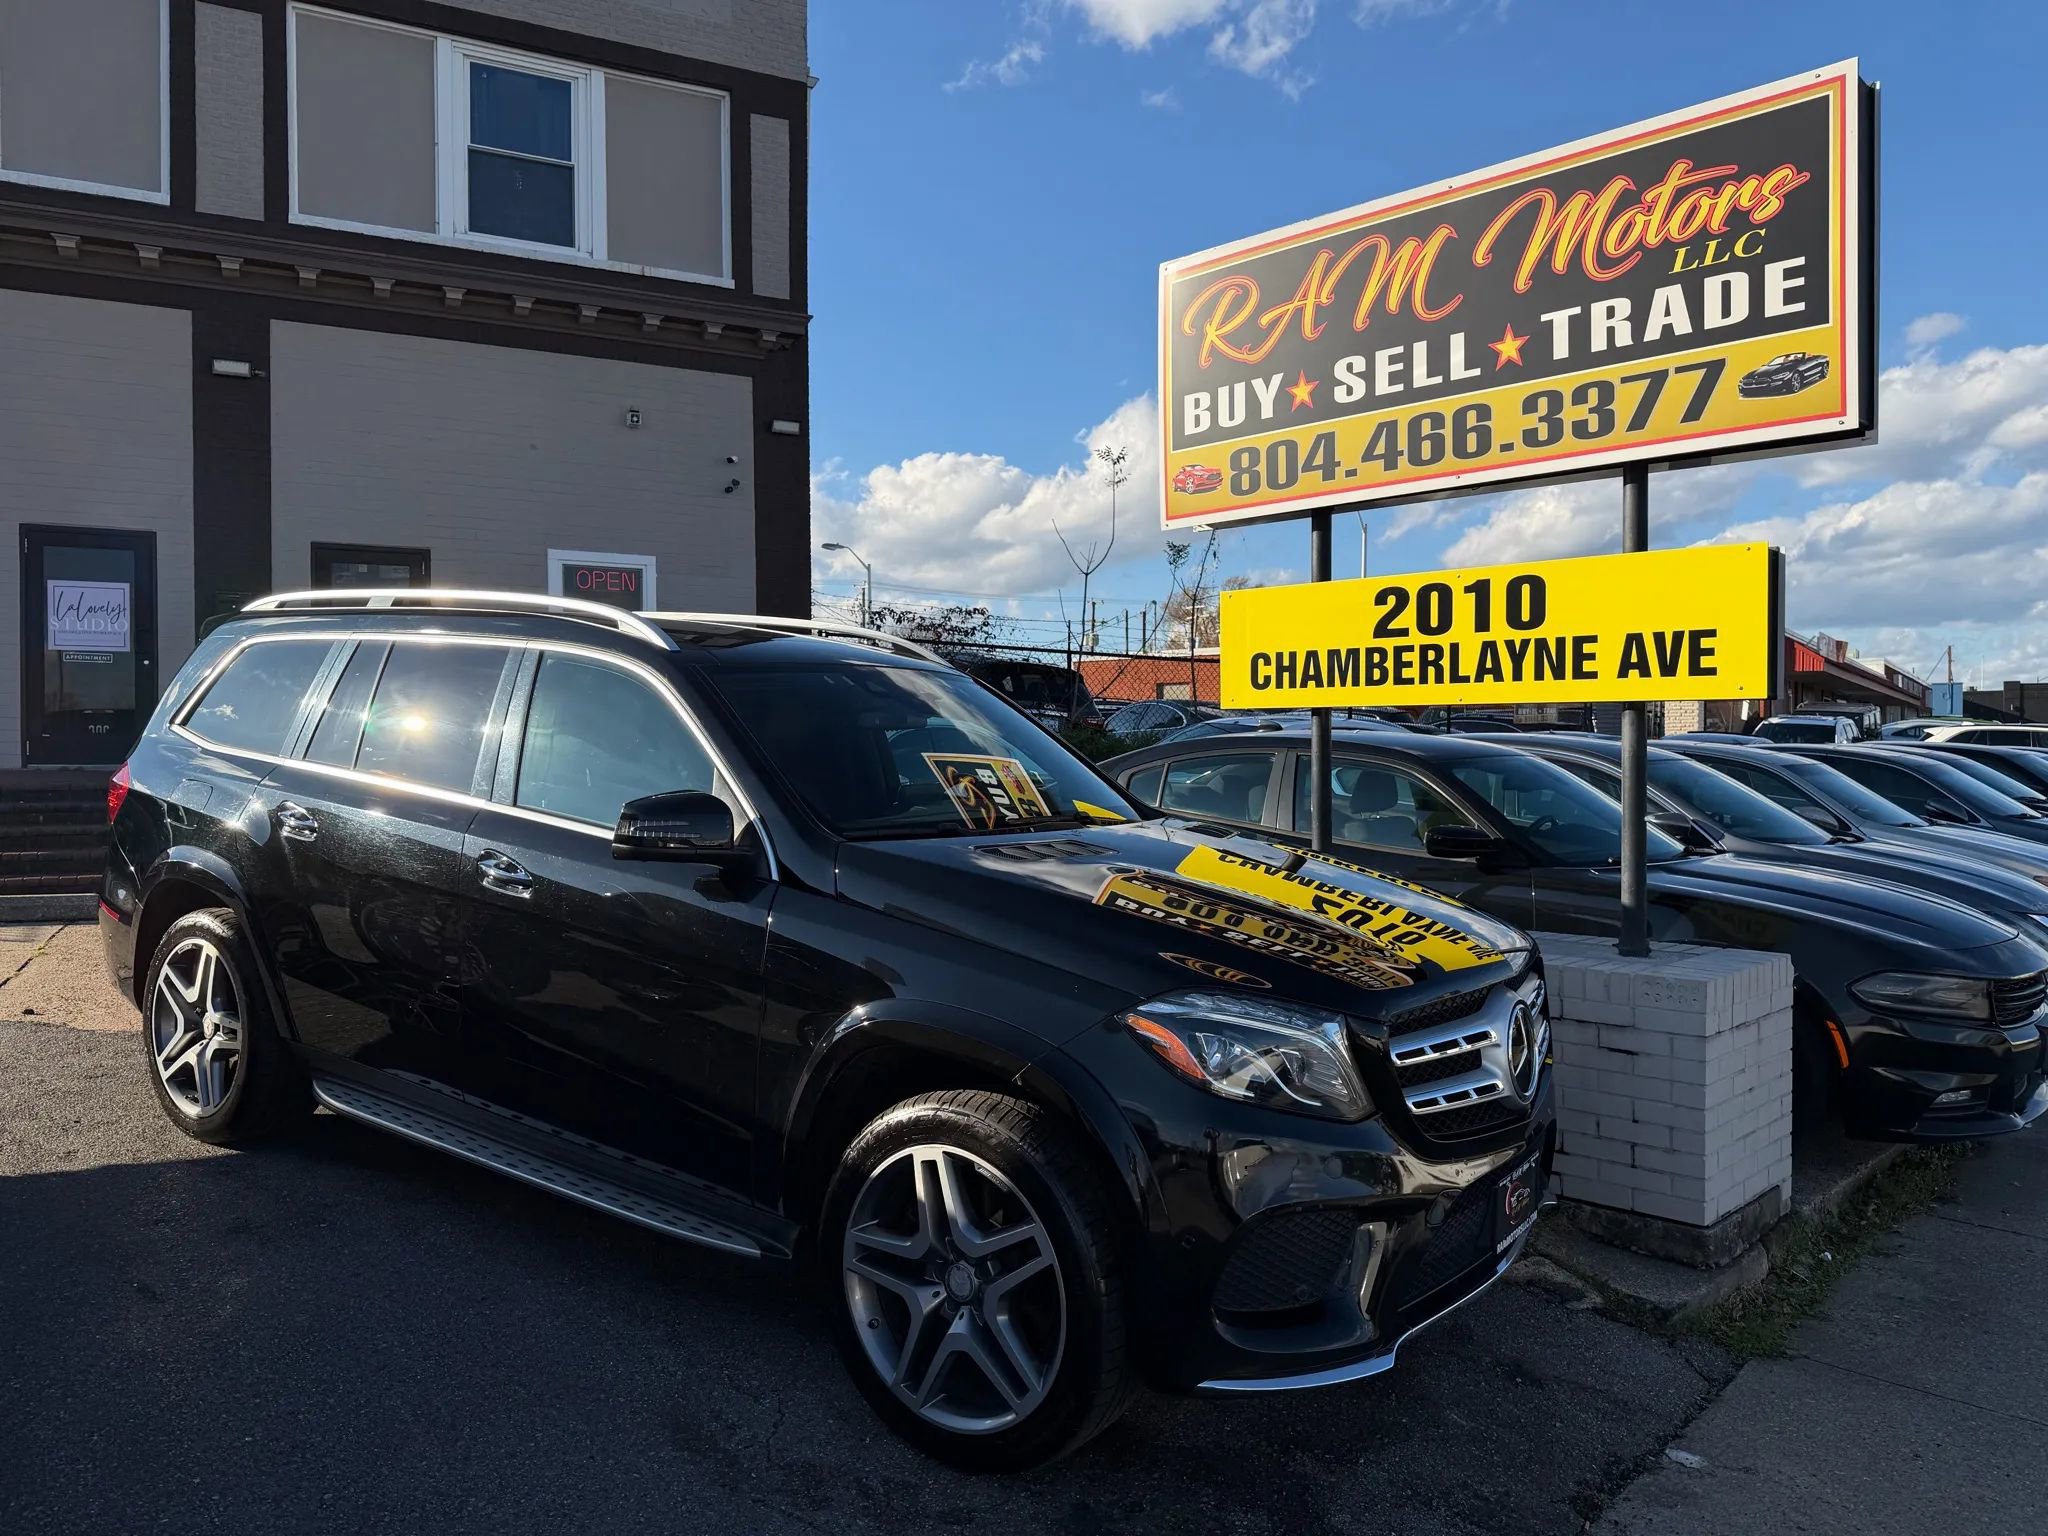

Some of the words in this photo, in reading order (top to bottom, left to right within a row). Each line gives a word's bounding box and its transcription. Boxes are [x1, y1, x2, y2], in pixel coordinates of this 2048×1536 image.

[1183, 223, 1464, 369] RAM
[1473, 159, 1811, 295] Motors
[1668, 228, 1768, 276] LLC
[1184, 374, 1283, 436] BUY
[1333, 331, 1482, 404] SELL
[1540, 256, 1807, 361] TRADE
[1228, 357, 1730, 498] 804.466.3377
[577, 569, 635, 592] OPEN
[1372, 574, 1548, 639] 2010
[50, 615, 128, 633] STUDIO
[1250, 634, 1600, 691] CHAMBERLAYNE
[1616, 628, 1718, 679] AVE
